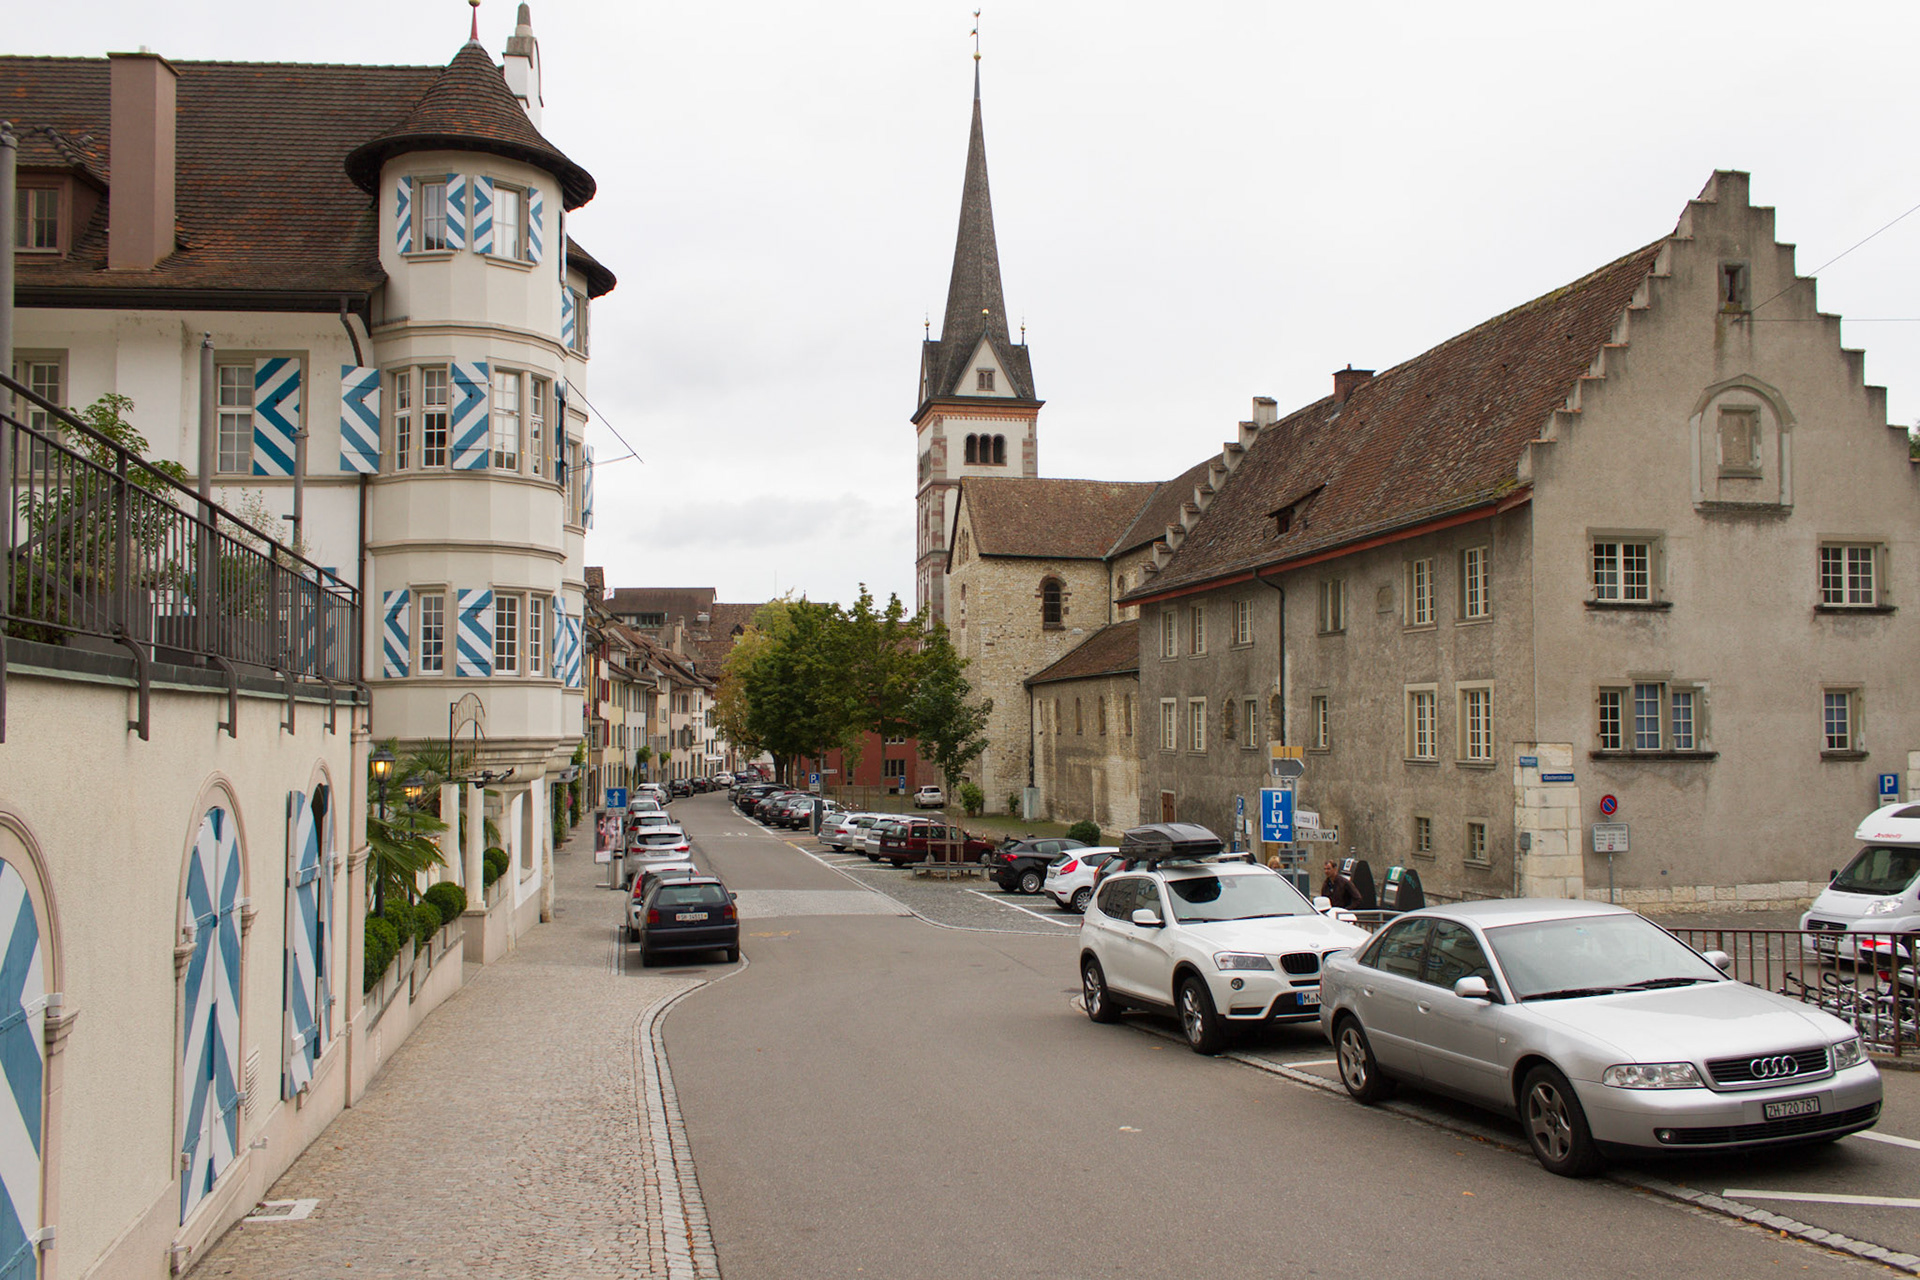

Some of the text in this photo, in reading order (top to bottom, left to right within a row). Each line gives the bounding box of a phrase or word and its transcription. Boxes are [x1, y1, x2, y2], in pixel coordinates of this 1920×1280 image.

[1884, 776, 1894, 792] P
[1272, 792, 1282, 809] P
[1321, 831, 1333, 840] WC
